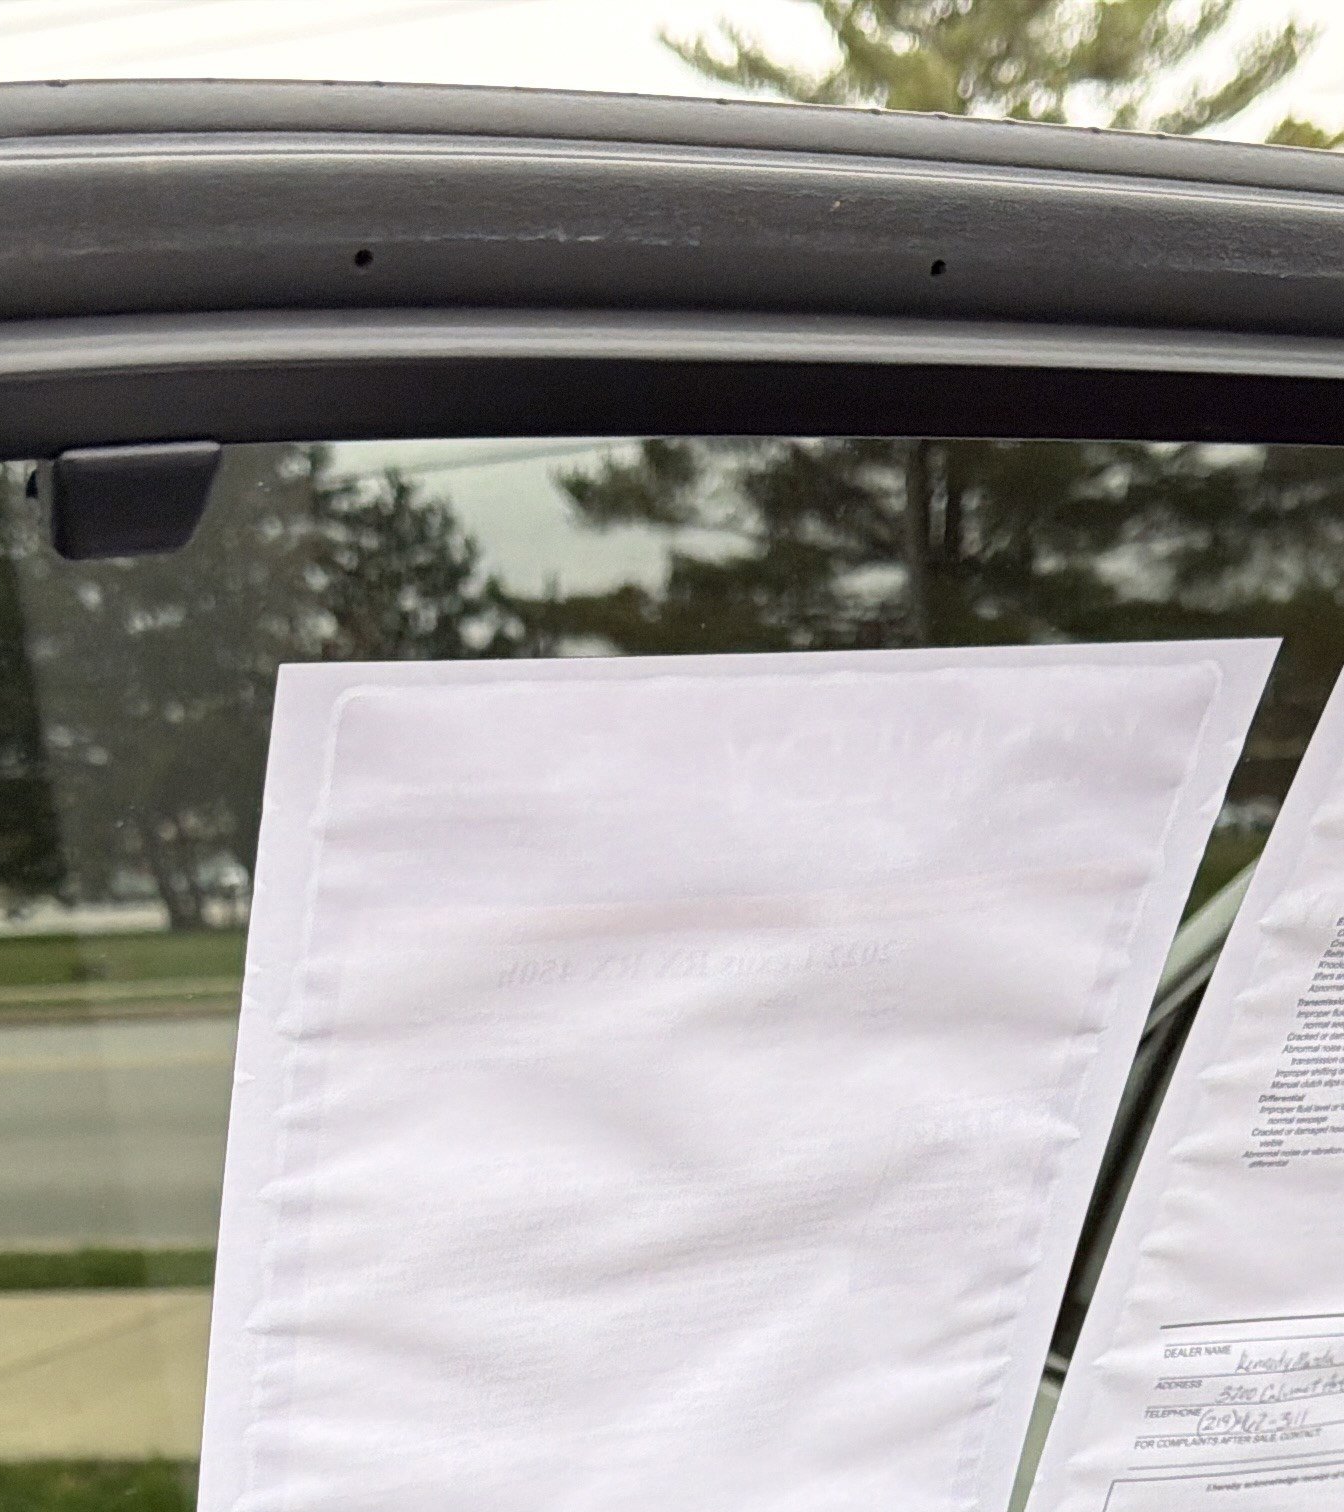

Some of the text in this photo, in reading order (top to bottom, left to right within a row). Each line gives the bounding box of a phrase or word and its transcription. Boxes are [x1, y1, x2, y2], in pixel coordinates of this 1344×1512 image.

[1164, 1345, 1231, 1358] DEALER NAME
[1155, 1379, 1202, 1389] ADDRESS
[1145, 1408, 1201, 1418] TELEPHONE
